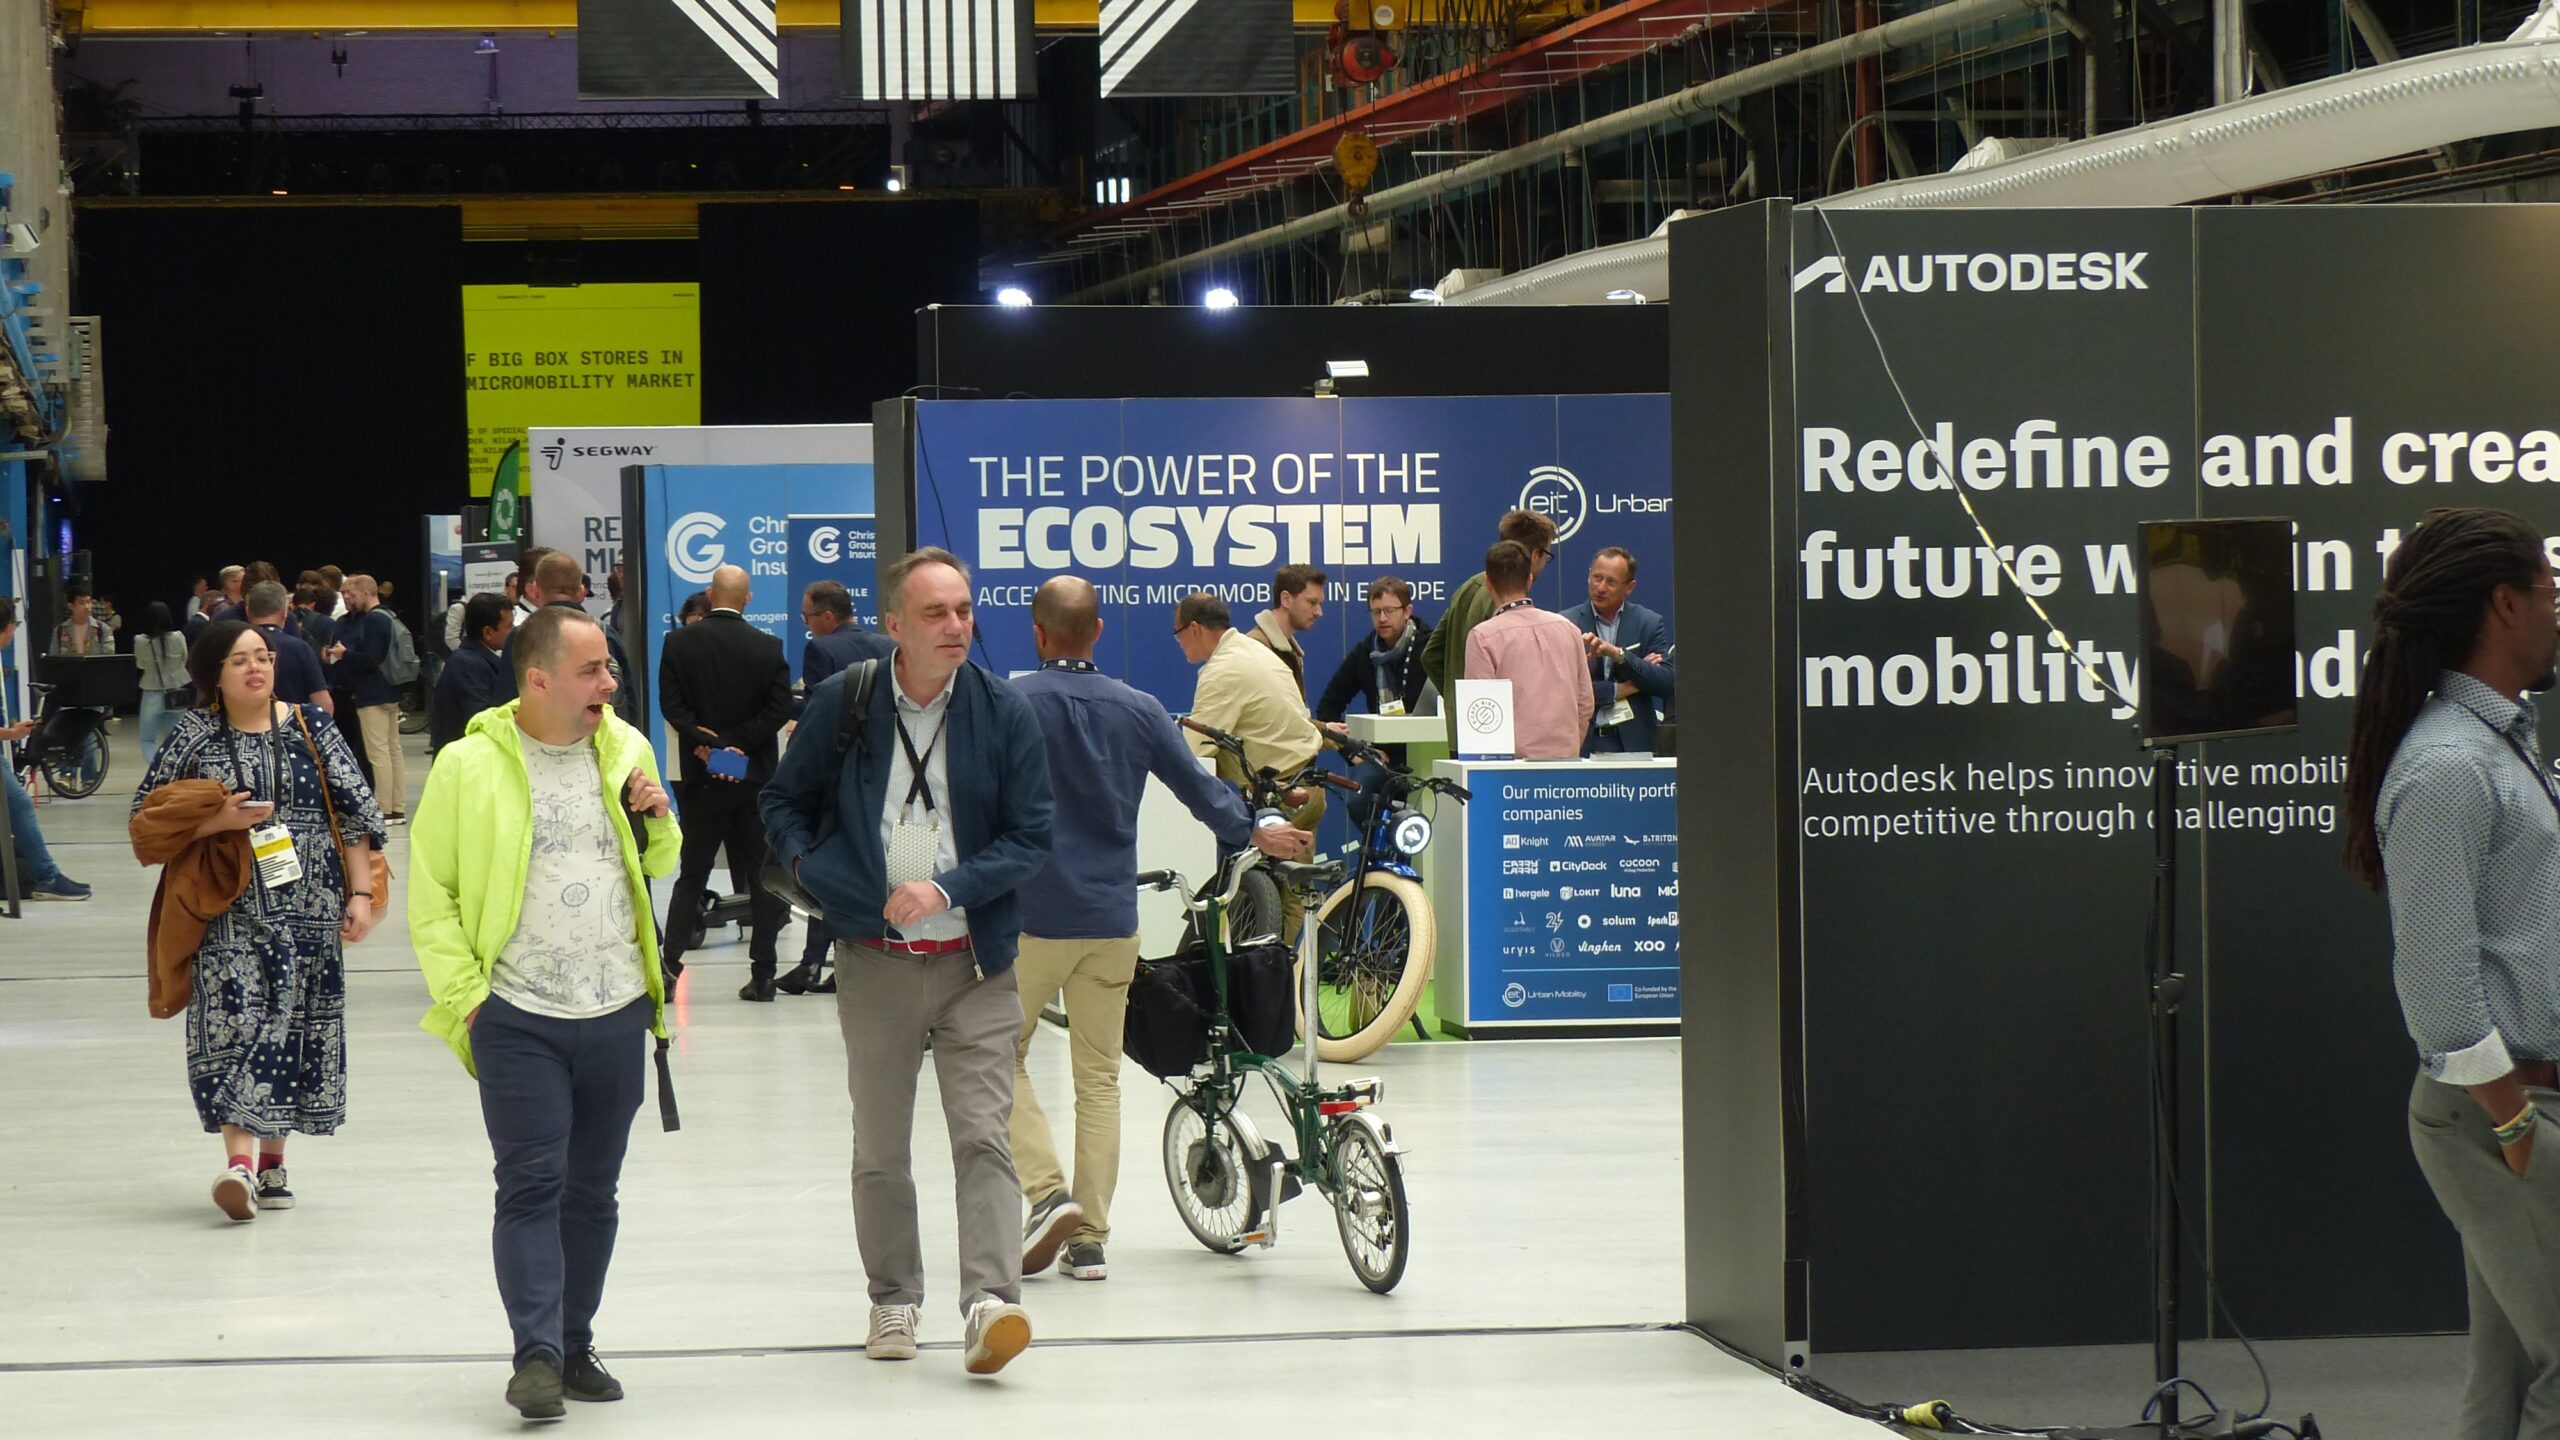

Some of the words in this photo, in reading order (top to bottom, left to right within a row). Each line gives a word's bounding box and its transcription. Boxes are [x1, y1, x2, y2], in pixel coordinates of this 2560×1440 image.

[1860, 251, 2149, 293] AUTODESK
[465, 353, 476, 367] F
[489, 352, 523, 366] BIG
[535, 351, 569, 366] BOX
[580, 350, 649, 365] STORES
[661, 350, 684, 364] IN
[466, 374, 614, 390] MICROMOBILITY
[627, 374, 695, 388] MARKET
[573, 446, 654, 457] SEGWAY
[1802, 419, 2170, 492] Redefine
[2201, 416, 2353, 487] and
[969, 456, 1064, 497] THE
[1081, 455, 1256, 497] POWER
[1272, 453, 1334, 495] OF
[1346, 453, 1440, 494] THE
[1530, 491, 1568, 514] eit
[849, 530, 876, 540] Chris
[978, 504, 1441, 570] ECOSYSTEM
[749, 537, 788, 555] Gro
[1800, 530, 2061, 600] future
[977, 584, 1140, 607] ACCETING
[1328, 581, 1350, 602] IN
[1357, 580, 1446, 602] EOPE
[1804, 629, 2139, 720] mobility
[1803, 763, 1957, 794] Autodesk
[1967, 761, 2054, 797] helps
[2064, 758, 2240, 789] innovtive
[2251, 755, 2347, 785] mobili
[1502, 784, 1530, 800] Our
[1533, 783, 1635, 802] micromobility
[1639, 782, 1677, 801] portf
[1502, 805, 1583, 825] companies
[1804, 806, 1996, 843] competitive
[2006, 802, 2135, 838] through
[1520, 836, 1549, 848] Knight
[1561, 860, 1607, 873] CityDock
[1619, 858, 1660, 868] cocoon
[1573, 888, 1601, 897] LOKIT
[1610, 883, 1641, 898] luna
[1602, 915, 1636, 926] solum
[1527, 991, 1549, 999] Urban
[1554, 990, 1587, 999] Mobility
